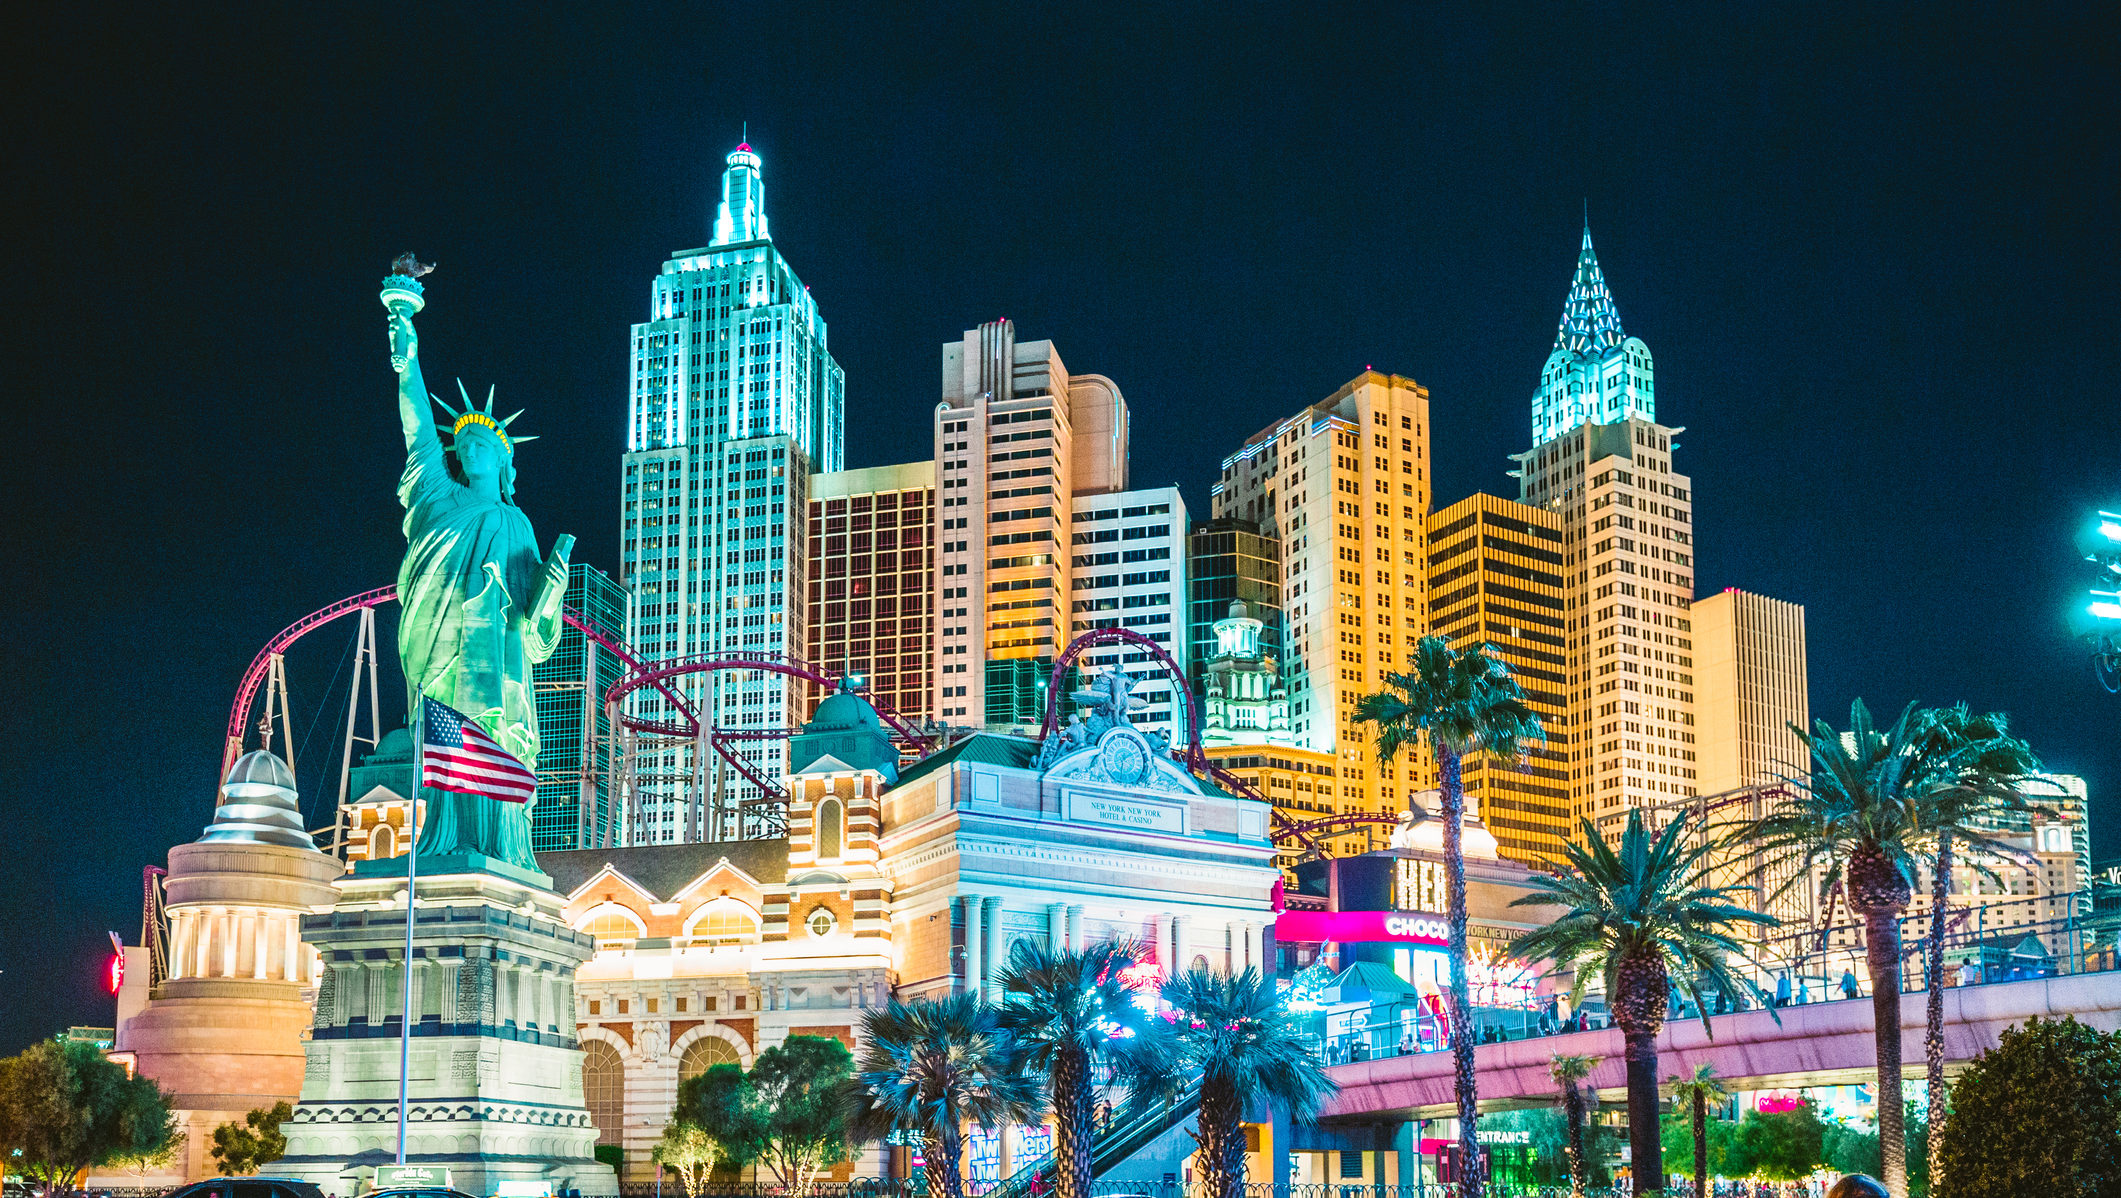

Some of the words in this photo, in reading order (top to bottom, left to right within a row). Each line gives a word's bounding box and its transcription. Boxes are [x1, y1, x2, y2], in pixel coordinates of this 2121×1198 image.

[1091, 802, 1105, 810] NEW
[1108, 804, 1126, 813] YORK
[1127, 807, 1142, 815] NEW
[1144, 809, 1161, 818] YORK
[1099, 811, 1120, 821] HOTEL
[1128, 816, 1152, 824] CASINO
[1466, 925, 1488, 938] YORK
[1488, 927, 1507, 940] NEW
[1475, 1130, 1530, 1143] ENTRANCE
